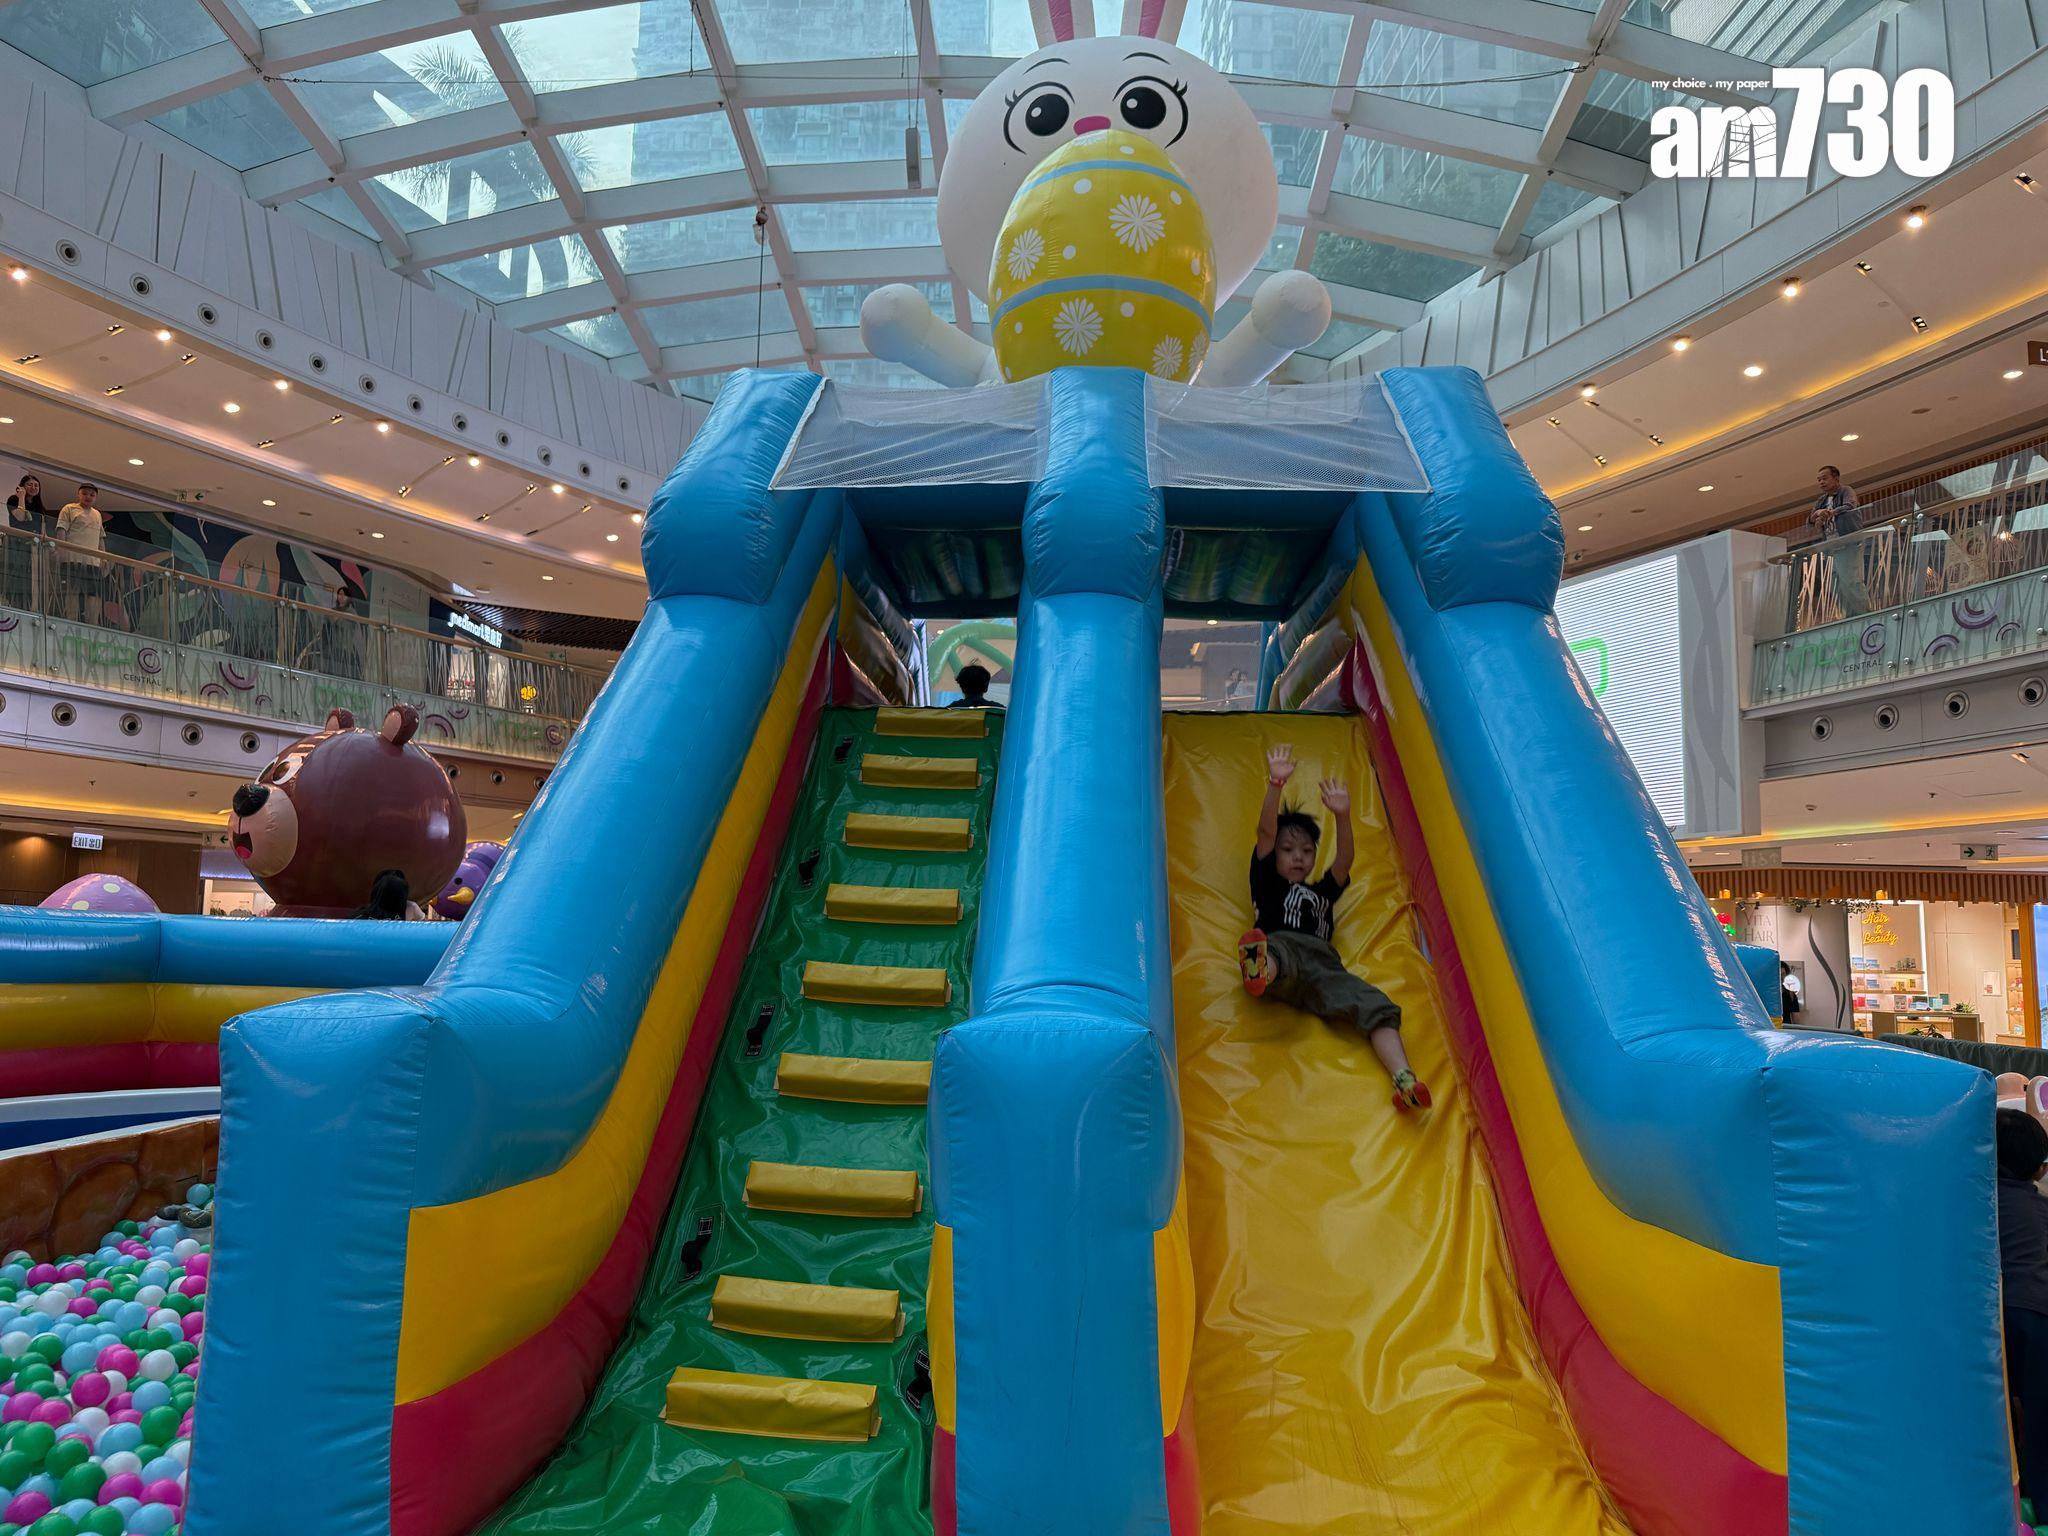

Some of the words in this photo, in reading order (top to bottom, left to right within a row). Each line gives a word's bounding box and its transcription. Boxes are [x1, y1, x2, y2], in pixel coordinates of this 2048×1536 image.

[1842, 659, 1883, 674] CENTRAL
[123, 673, 162, 687] CENTRAL
[73, 836, 88, 847] EXIT
[88, 838, 101, 849] 出口
[1743, 909, 1772, 926] VITA
[1862, 911, 1889, 925] Hair
[1744, 928, 1775, 944] HAIR
[1863, 930, 1898, 946] Beauty
